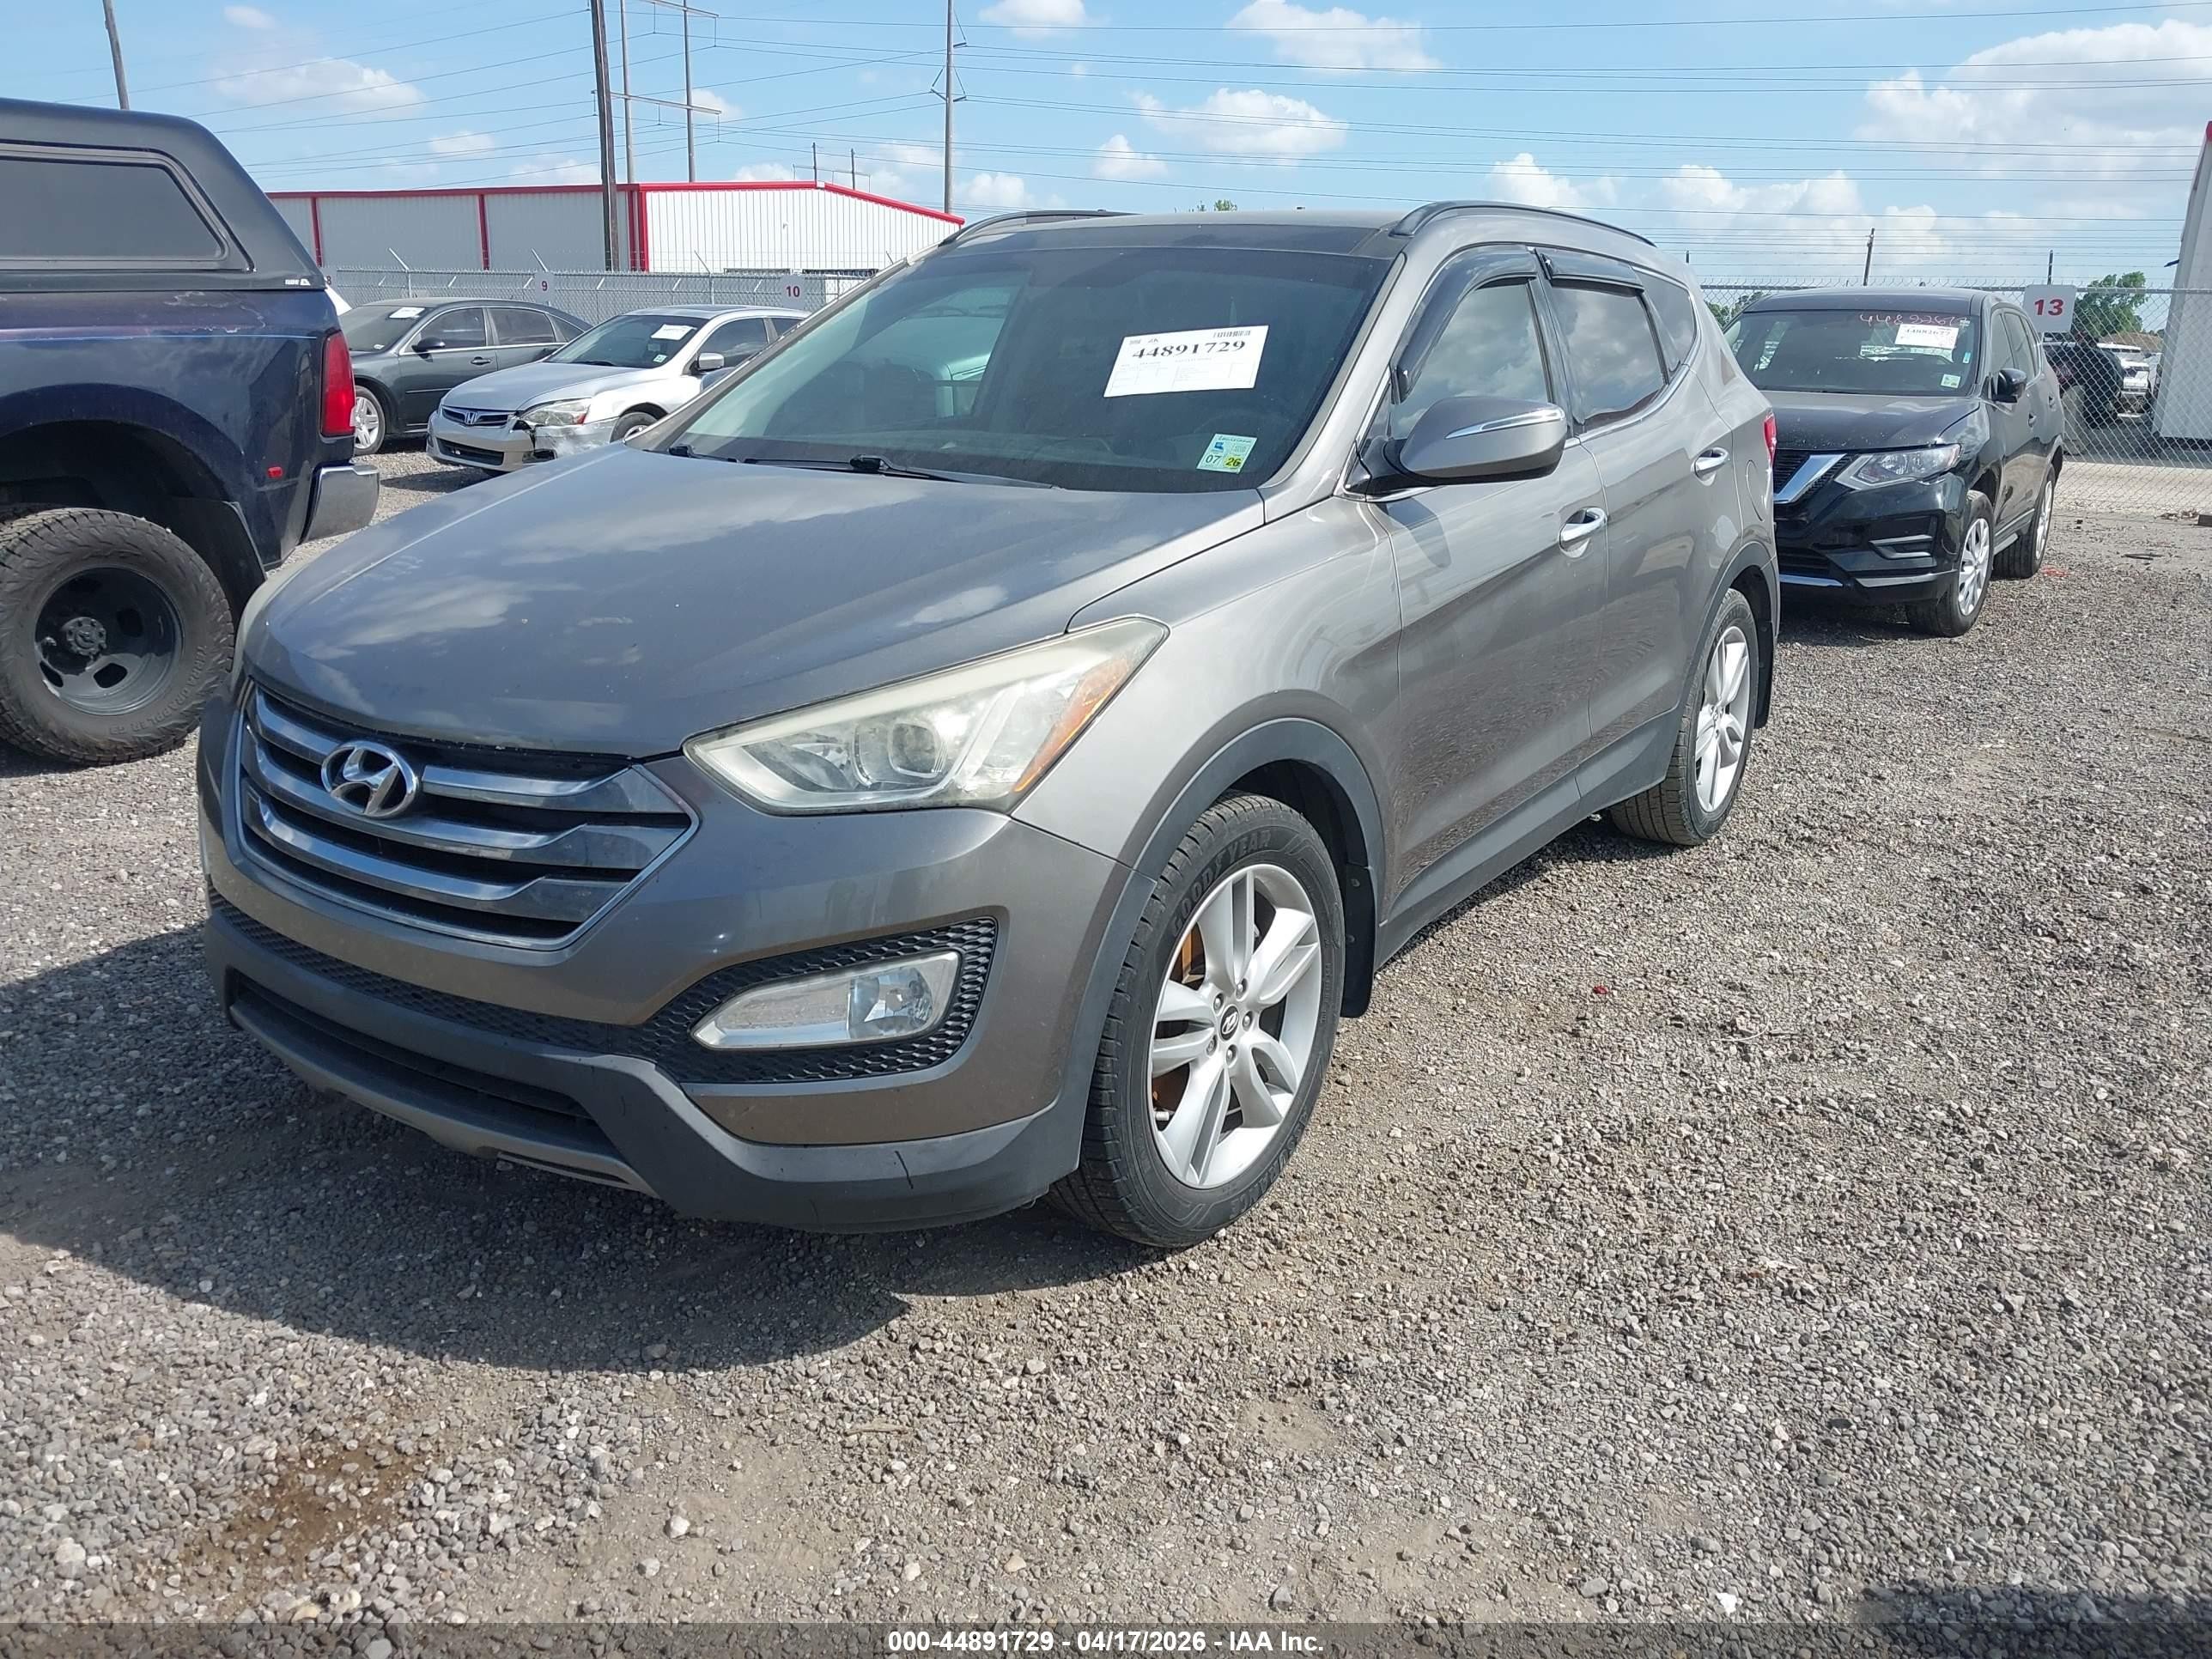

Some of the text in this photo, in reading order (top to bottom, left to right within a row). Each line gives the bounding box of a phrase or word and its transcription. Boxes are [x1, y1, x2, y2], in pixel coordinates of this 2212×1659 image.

[541, 280, 548, 292] 9
[786, 285, 800, 297] 10
[2033, 298, 2064, 316] 13
[1132, 339, 1246, 359] 44891729
[1205, 453, 1242, 467] 07 26
[1173, 829, 1273, 940] GOODYEAR
